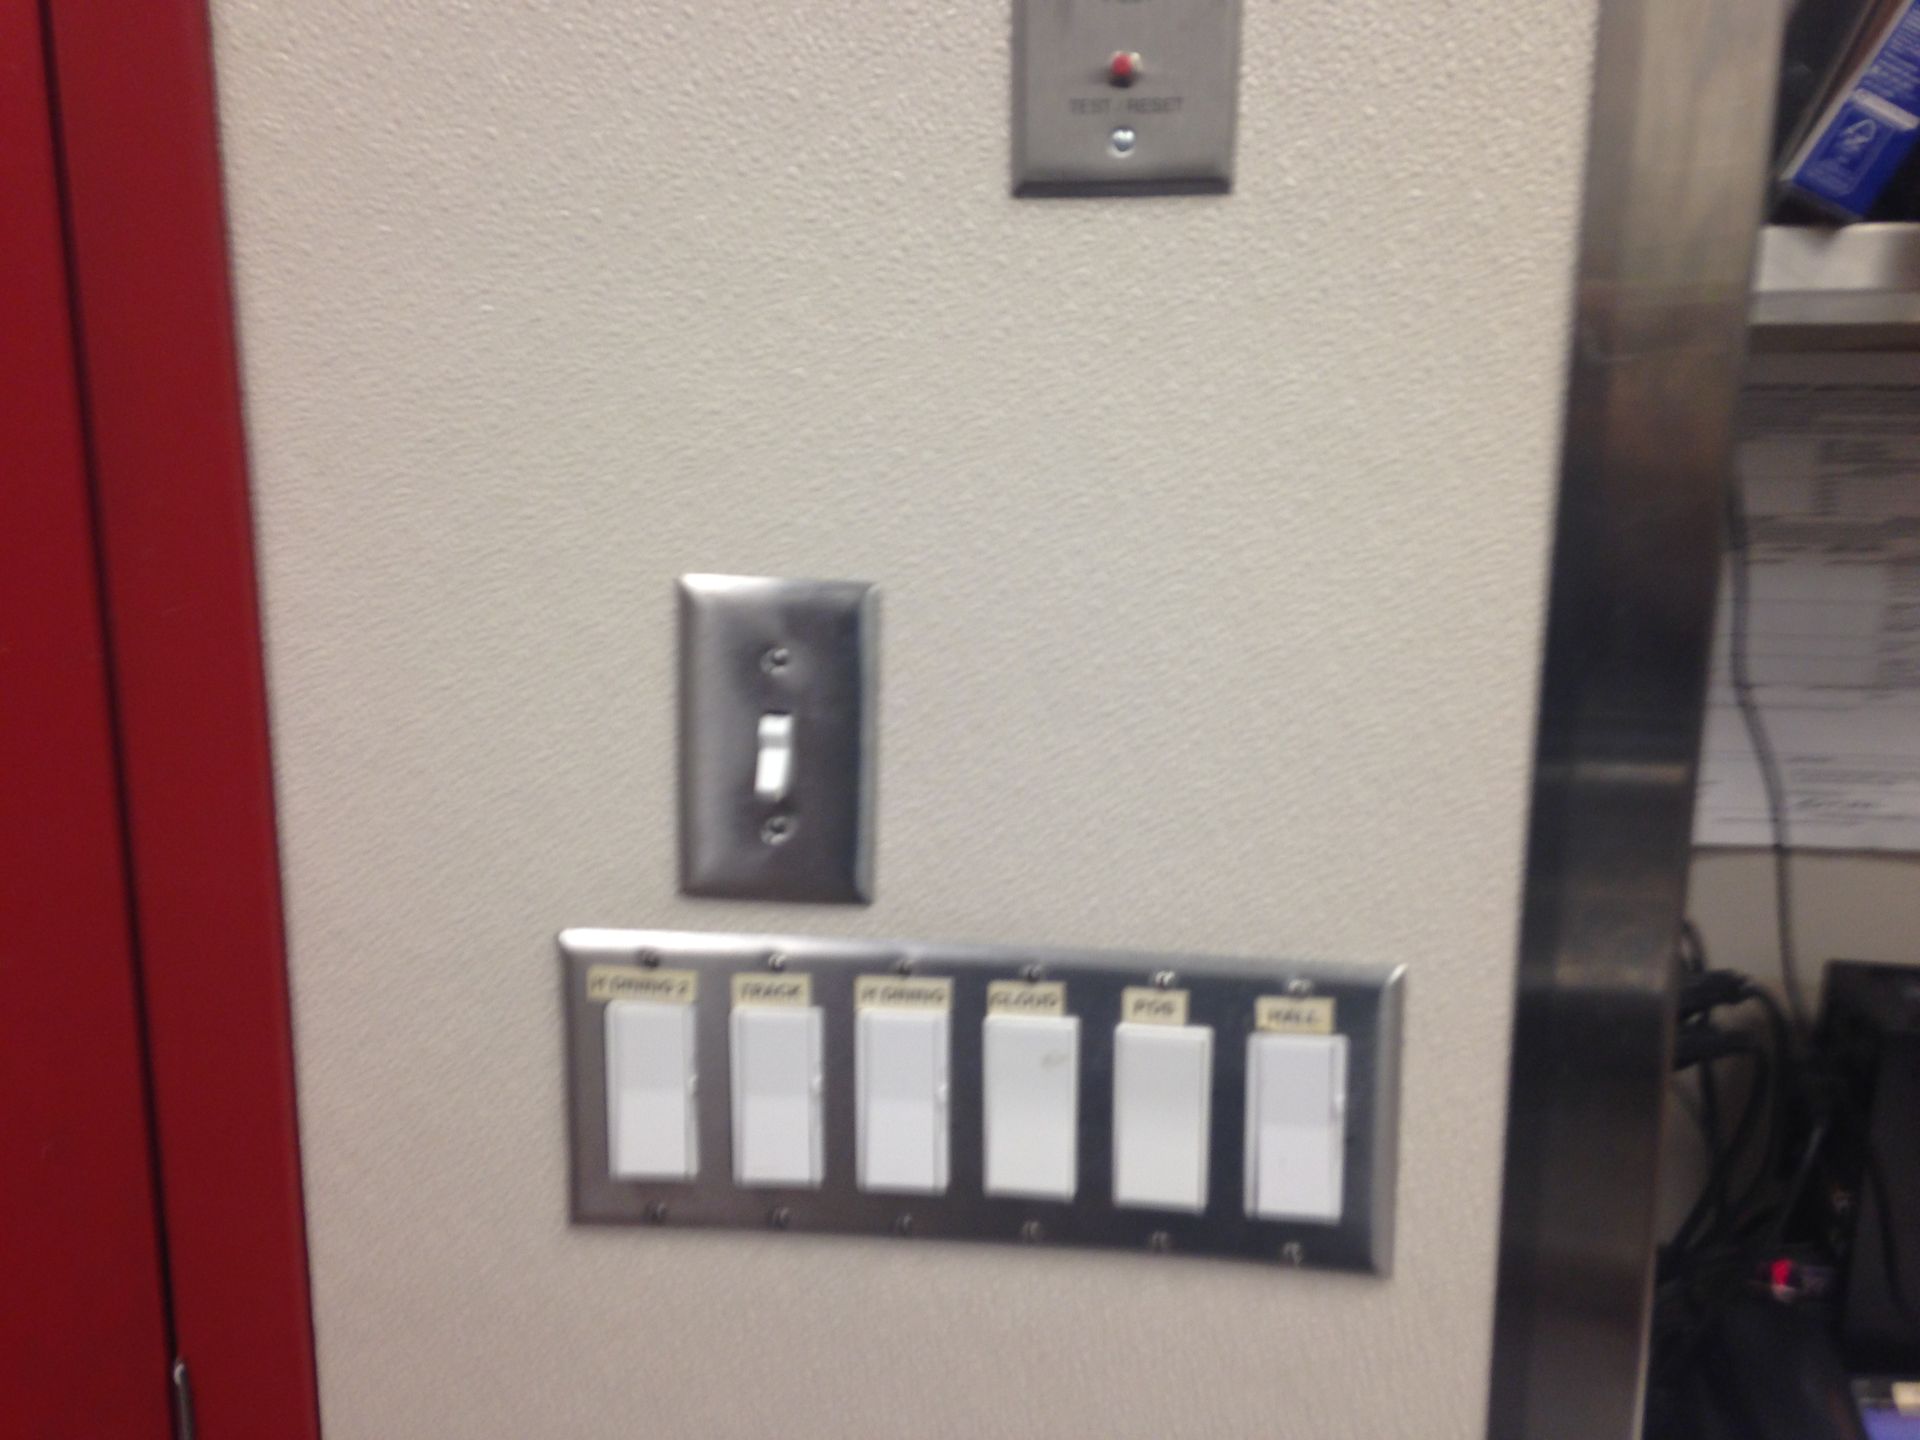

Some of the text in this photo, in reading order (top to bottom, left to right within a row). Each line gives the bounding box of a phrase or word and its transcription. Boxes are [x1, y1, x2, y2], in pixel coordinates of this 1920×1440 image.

[1126, 96, 1184, 115] RESET
[740, 981, 801, 1001] TRACK
[1267, 1006, 1324, 1026] HALL
